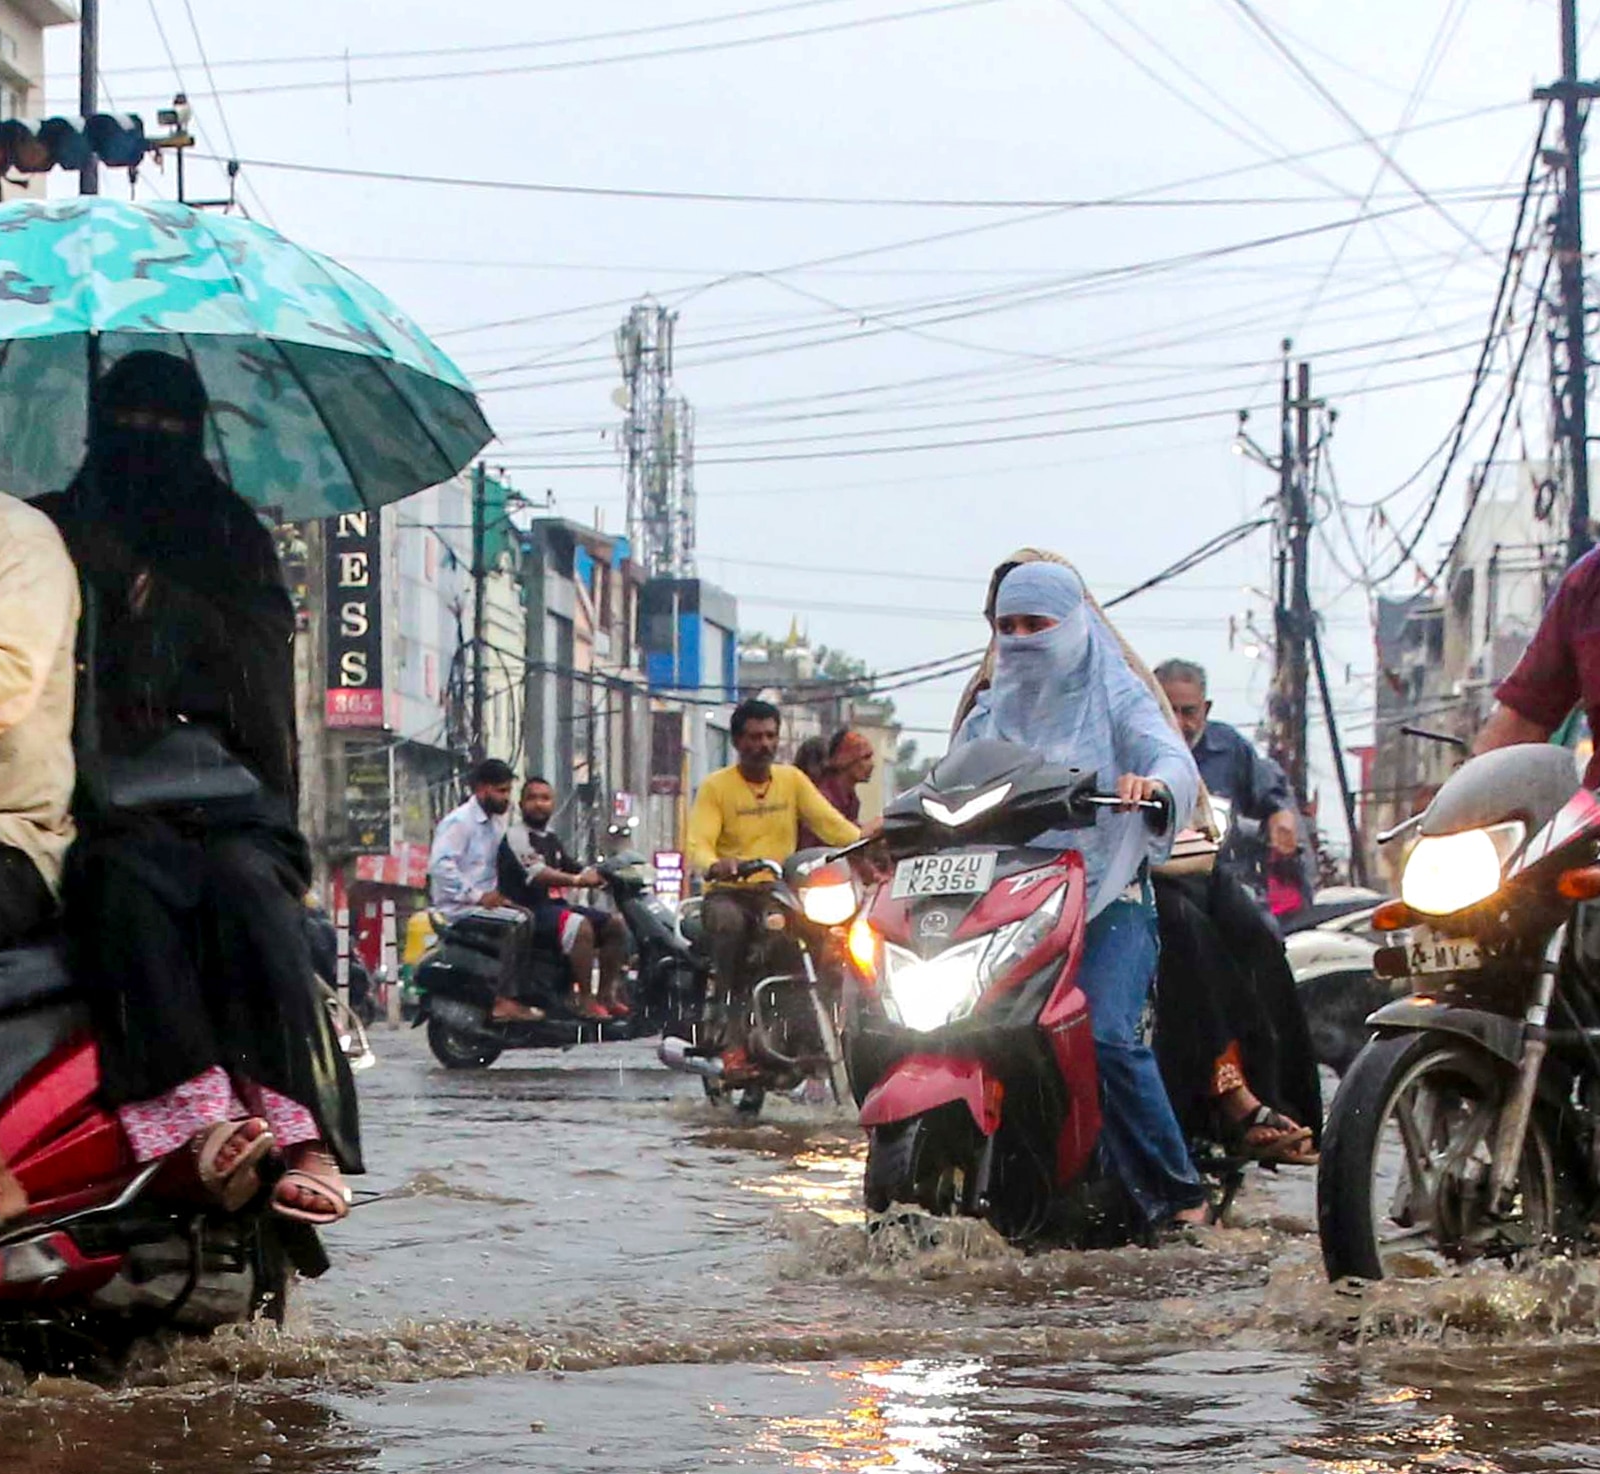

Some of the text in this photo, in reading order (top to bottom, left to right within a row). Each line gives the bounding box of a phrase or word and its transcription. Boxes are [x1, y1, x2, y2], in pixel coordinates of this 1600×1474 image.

[334, 693, 374, 713] 365
[912, 857, 983, 876] MP04U
[907, 873, 977, 895] K2356
